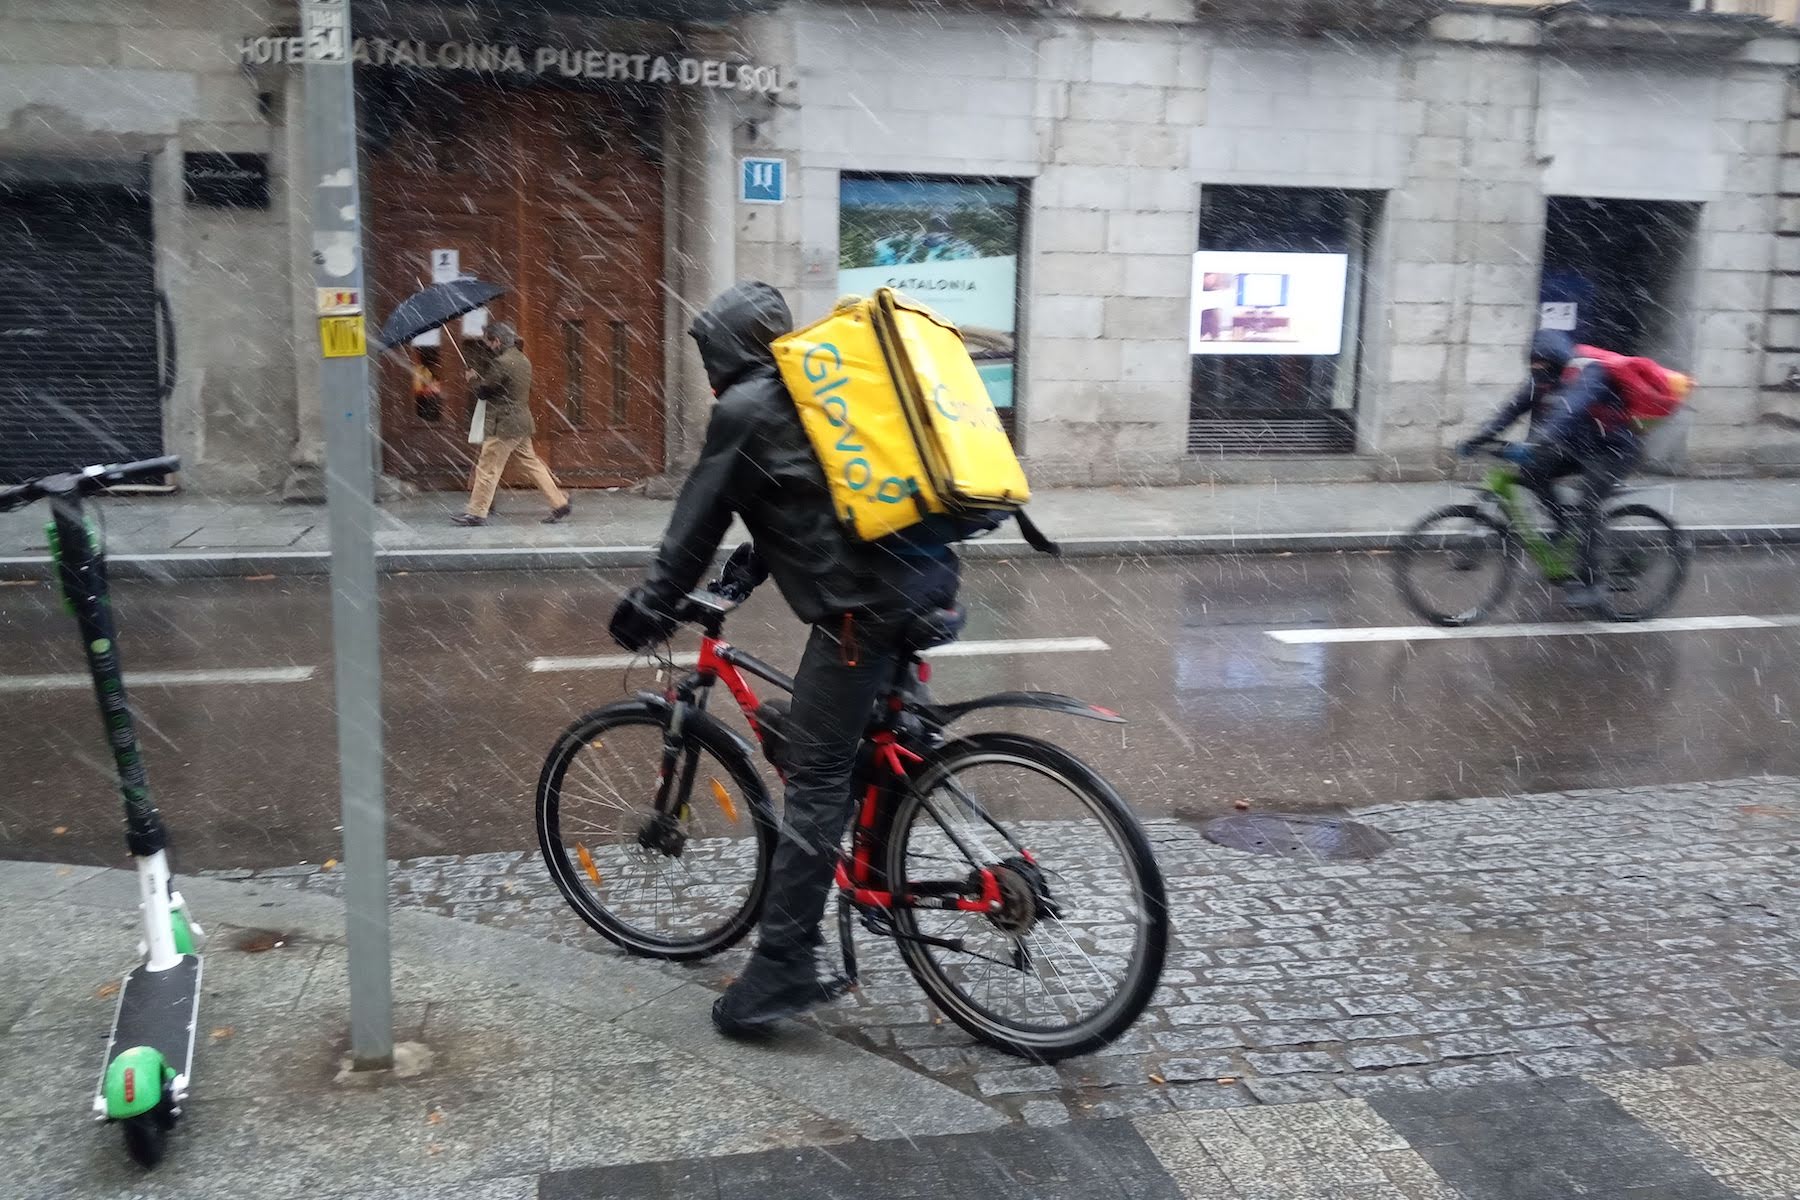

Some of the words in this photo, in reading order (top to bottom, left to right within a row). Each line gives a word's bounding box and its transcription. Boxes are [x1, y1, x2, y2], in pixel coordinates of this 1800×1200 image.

[239, 36, 304, 65] HOTE
[351, 36, 526, 74] ATALONIA
[537, 47, 672, 84] PUERTA
[679, 57, 736, 89] DEL
[735, 64, 783, 93] SOL
[885, 277, 977, 291] CATALONIA
